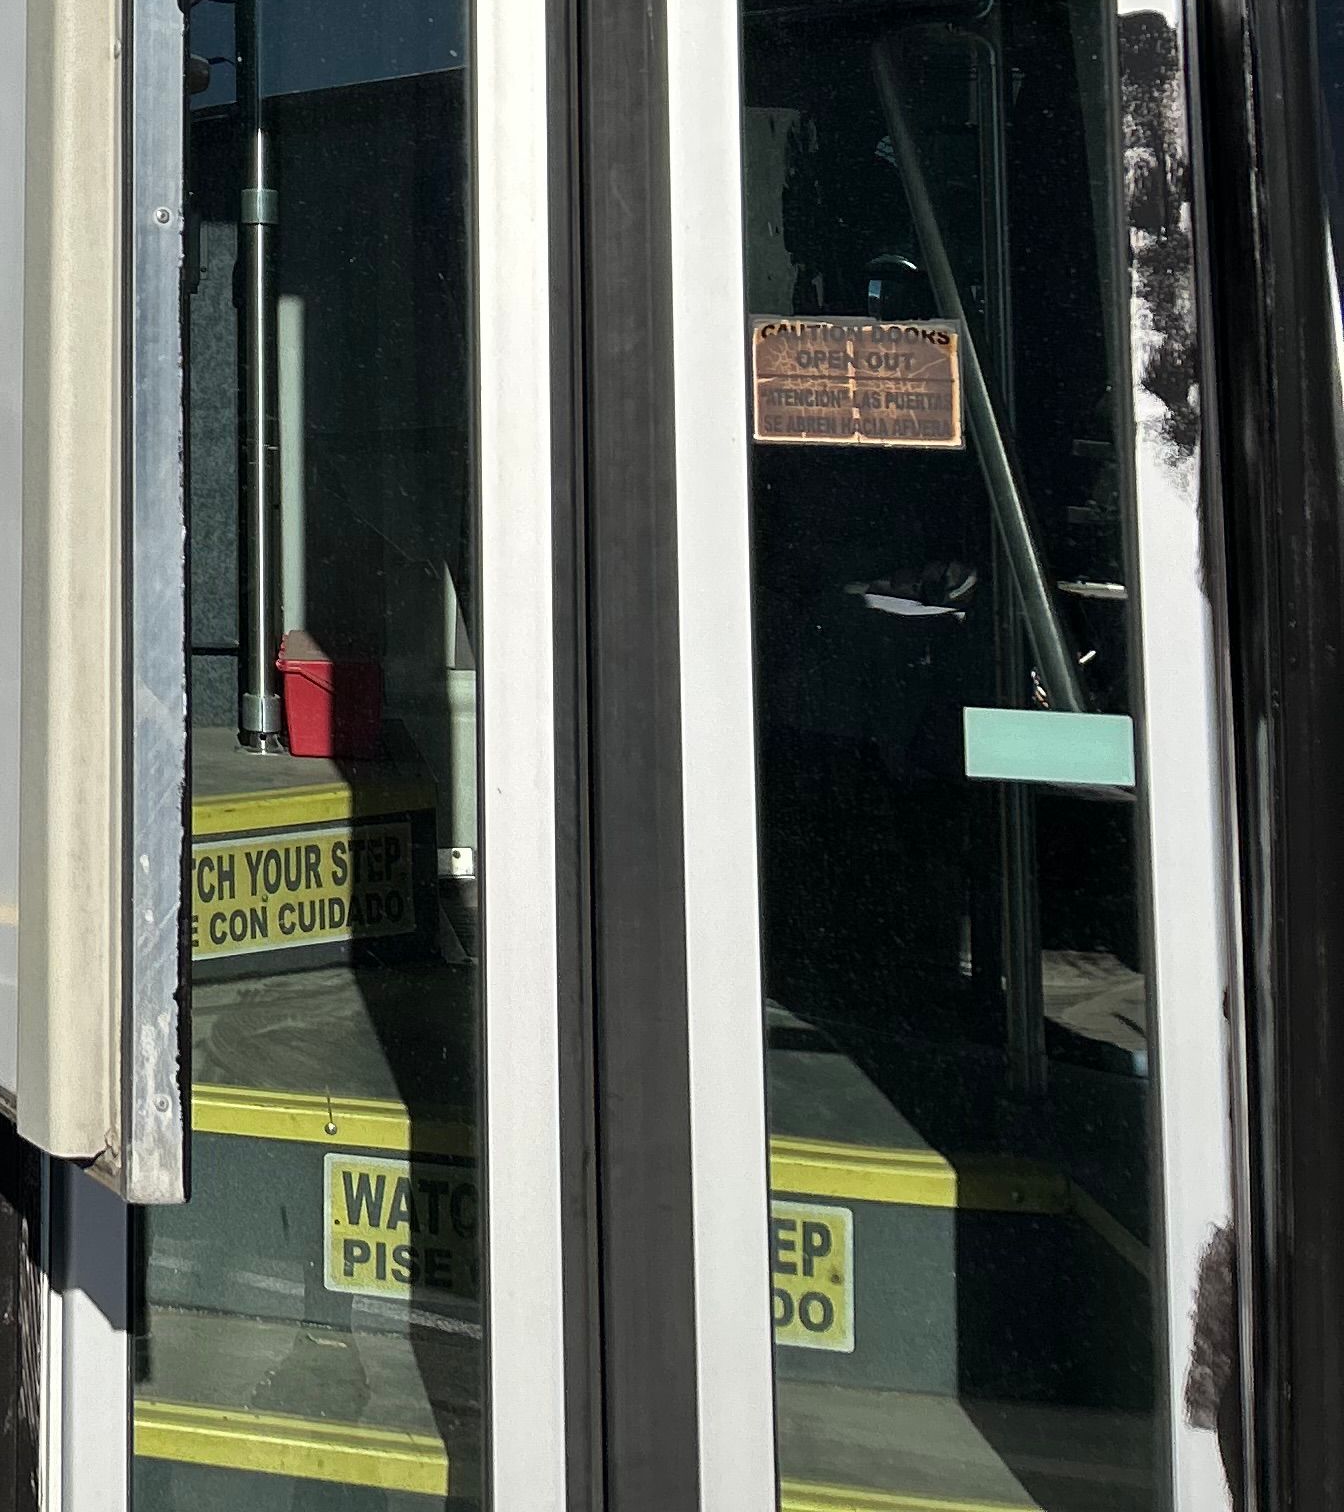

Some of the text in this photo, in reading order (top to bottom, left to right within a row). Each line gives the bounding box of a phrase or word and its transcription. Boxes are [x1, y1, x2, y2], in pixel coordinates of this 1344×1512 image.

[761, 324, 862, 342] CAUTION
[797, 350, 914, 371] OPEN OUT
[853, 390, 881, 409] LAS
[763, 414, 782, 432] SE
[786, 415, 836, 434] ABREN
[840, 416, 888, 435] HACIA
[192, 854, 235, 903] CH
[245, 844, 324, 897] YOUR
[209, 906, 269, 946] CON
[277, 889, 404, 936] CUIDADO
[343, 1171, 477, 1238] WATC
[343, 1239, 455, 1287] PISE
